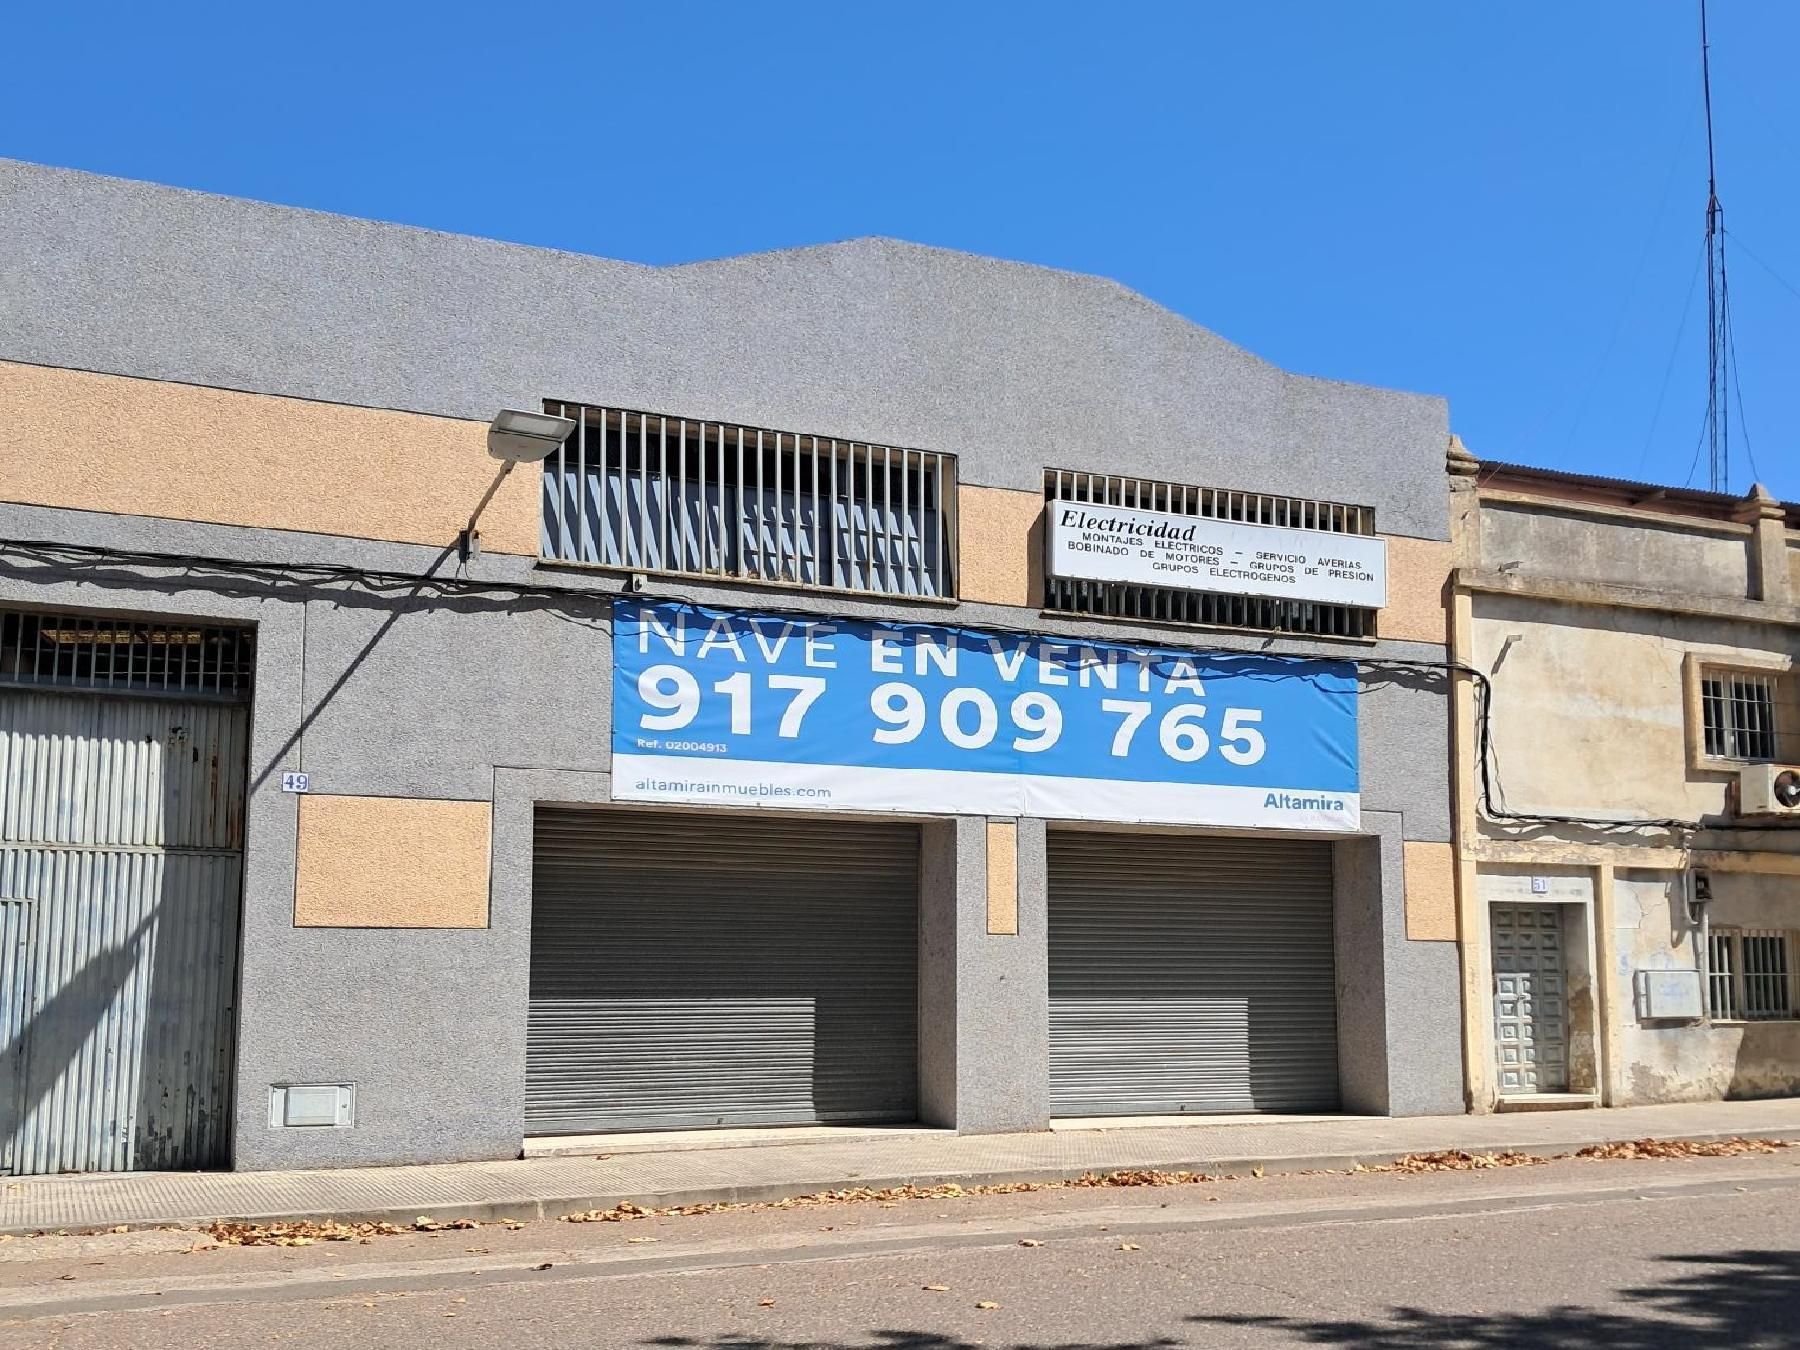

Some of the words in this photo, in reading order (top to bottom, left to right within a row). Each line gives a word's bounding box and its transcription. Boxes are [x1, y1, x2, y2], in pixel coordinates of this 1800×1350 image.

[1061, 510, 1196, 541] Electricidad
[1068, 541, 1129, 556] BOBINADO
[1140, 550, 1155, 559] DE
[1165, 552, 1219, 566] MOTORES
[1250, 561, 1294, 573] GRUPOS
[1304, 567, 1319, 576] DE
[1328, 569, 1374, 582] PRESION
[1082, 532, 1143, 546] MONTAJES
[1154, 540, 1223, 556] ELECTRICOS
[1256, 551, 1306, 564] SERVICIO
[1318, 557, 1361, 570] AVERIAS
[1152, 562, 1199, 574] GRUPOS
[1209, 568, 1296, 584] ELECTROGENOS
[639, 608, 838, 669] NAVE
[871, 630, 958, 677] EN
[987, 639, 1206, 697] VENTA
[637, 664, 826, 738] 917
[870, 681, 1064, 753] 909
[1101, 698, 1267, 766] 765
[637, 738, 662, 749] Ref.
[665, 742, 728, 753] 02004913
[284, 775, 308, 790] 49
[635, 777, 832, 798] altamirainmuebles.com
[1264, 793, 1344, 811] Altamira
